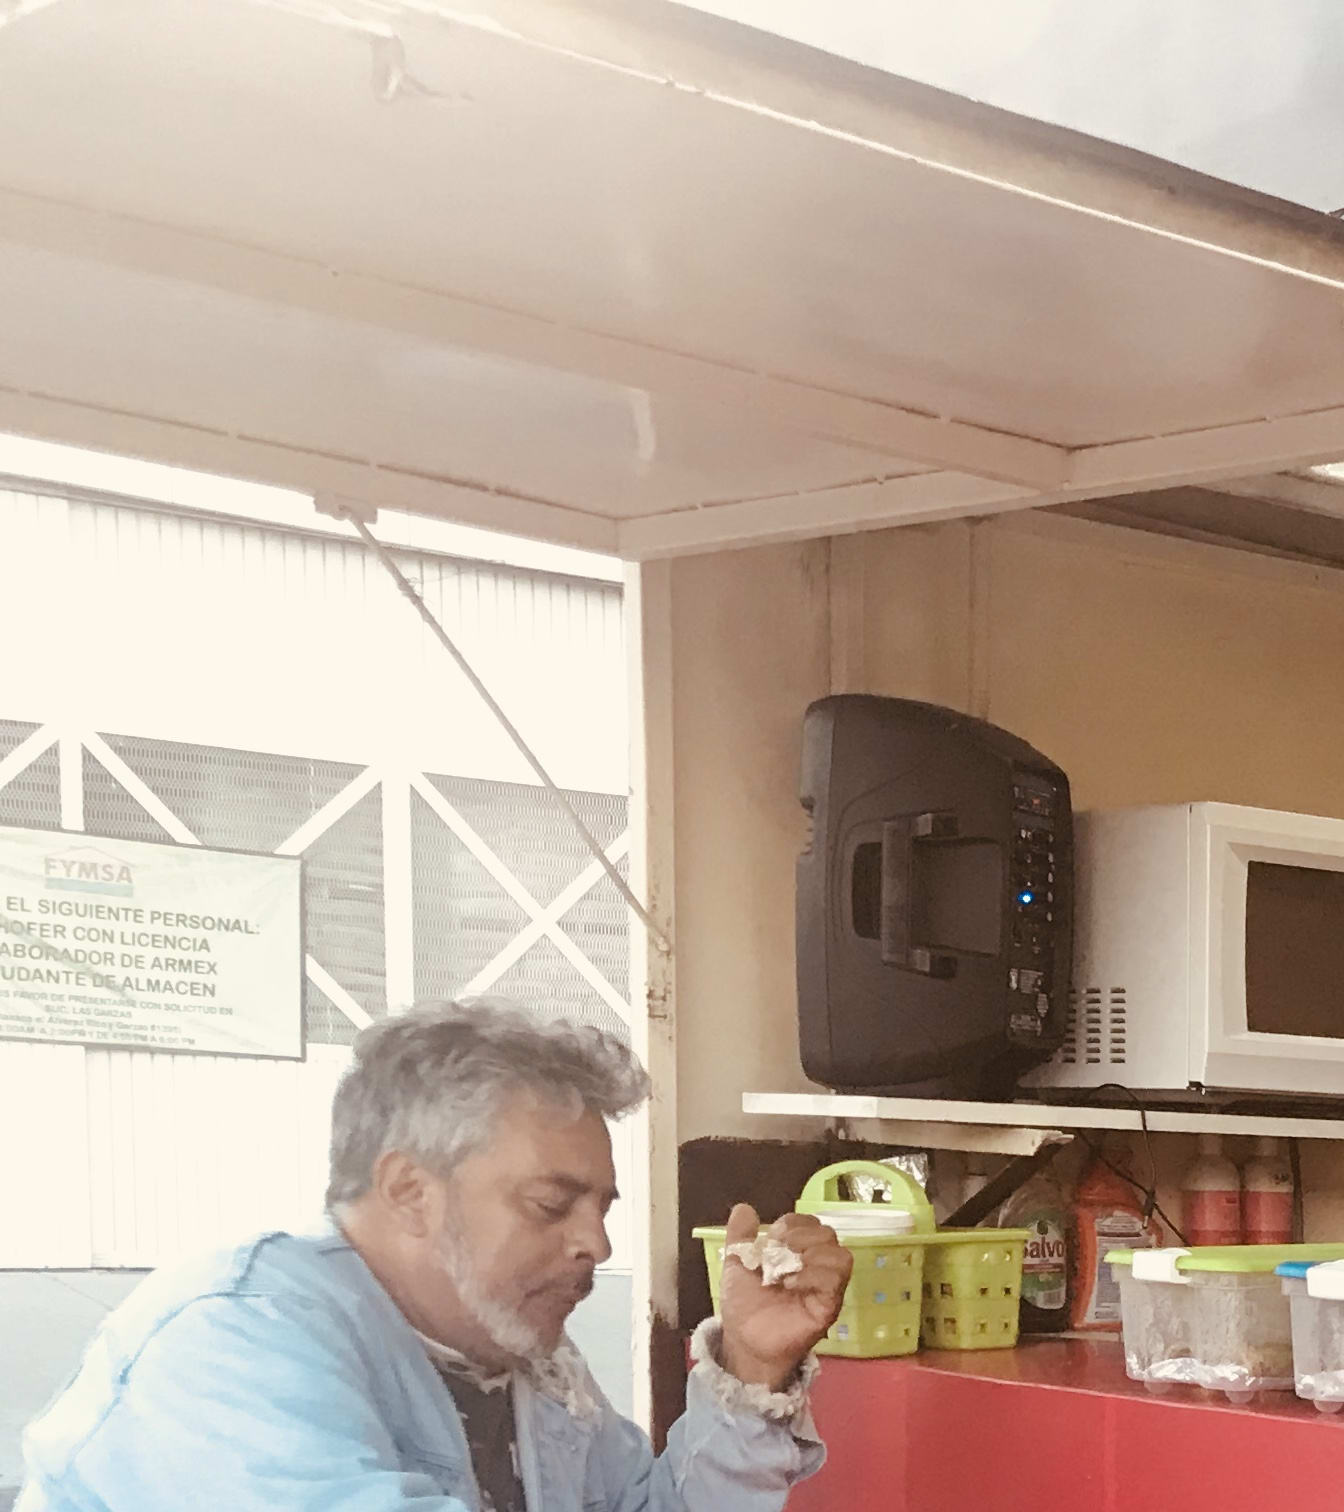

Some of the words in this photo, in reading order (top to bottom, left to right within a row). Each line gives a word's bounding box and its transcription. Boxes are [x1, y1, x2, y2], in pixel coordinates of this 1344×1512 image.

[45, 857, 133, 884] FYMSA
[6, 896, 32, 913] EL
[38, 899, 145, 924] SIGUIENTE
[150, 910, 260, 936] PERSONAL:
[73, 926, 115, 944] CON
[120, 931, 211, 953] LICENCIA
[120, 953, 146, 970] DE
[150, 956, 218, 976] ARMEX
[92, 973, 117, 988] DE
[122, 976, 216, 998] ALMACEN
